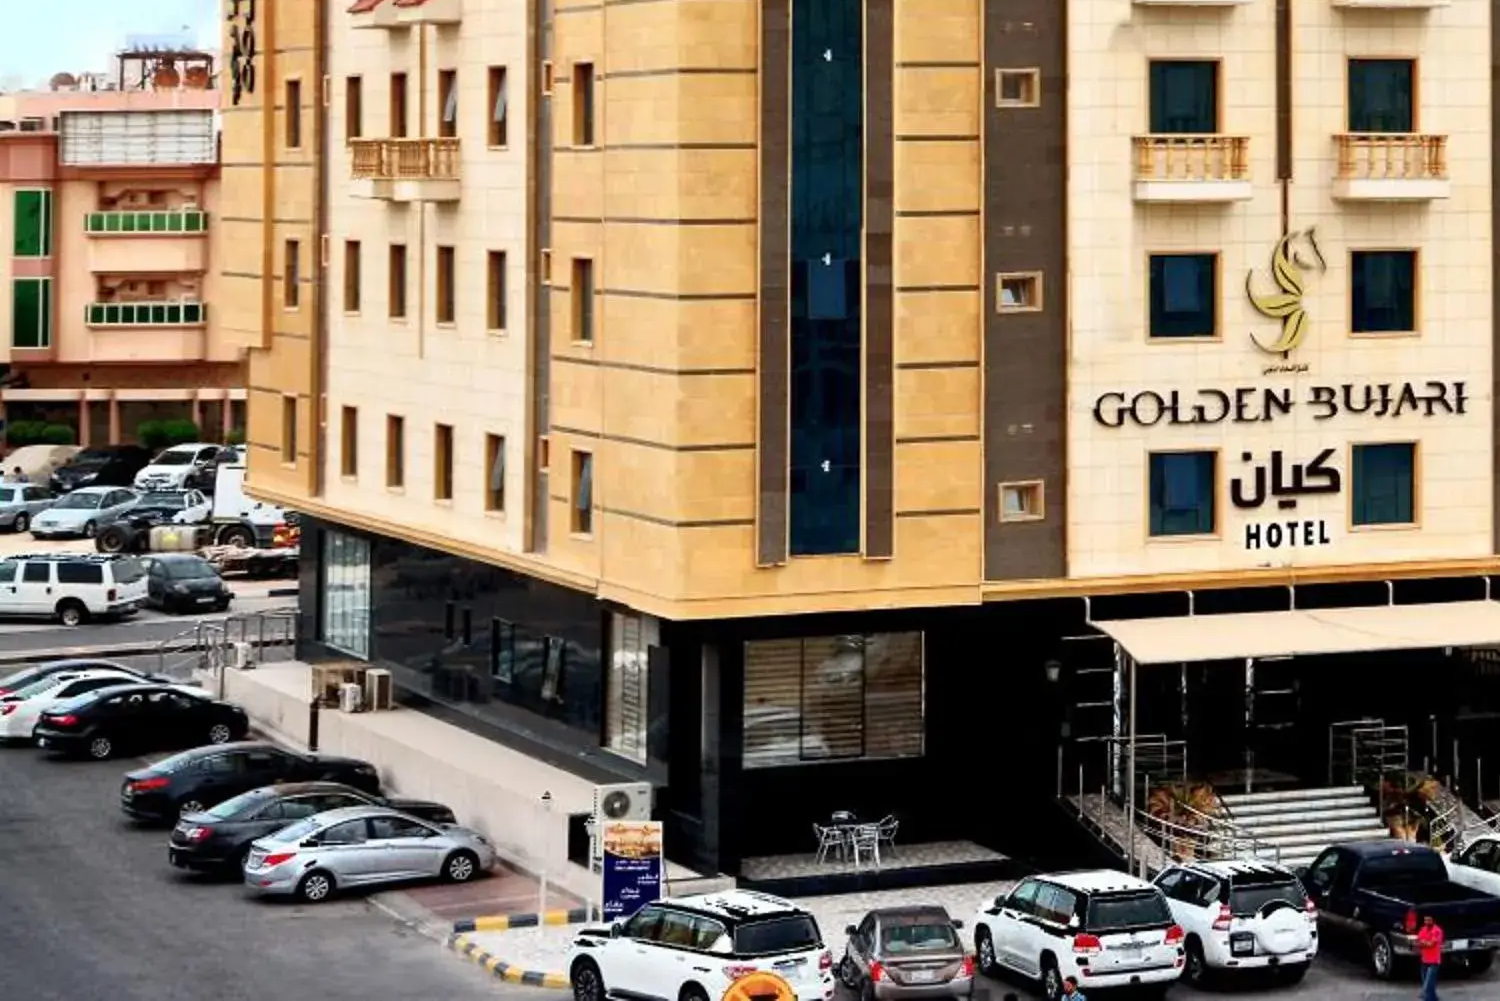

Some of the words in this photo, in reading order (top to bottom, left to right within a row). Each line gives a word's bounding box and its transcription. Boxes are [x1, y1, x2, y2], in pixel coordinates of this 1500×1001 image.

[1093, 386, 1295, 428] GOLDEN
[1306, 380, 1469, 421] BUJARI
[1230, 448, 1341, 511] كيان
[1245, 520, 1331, 550] HOTEL
